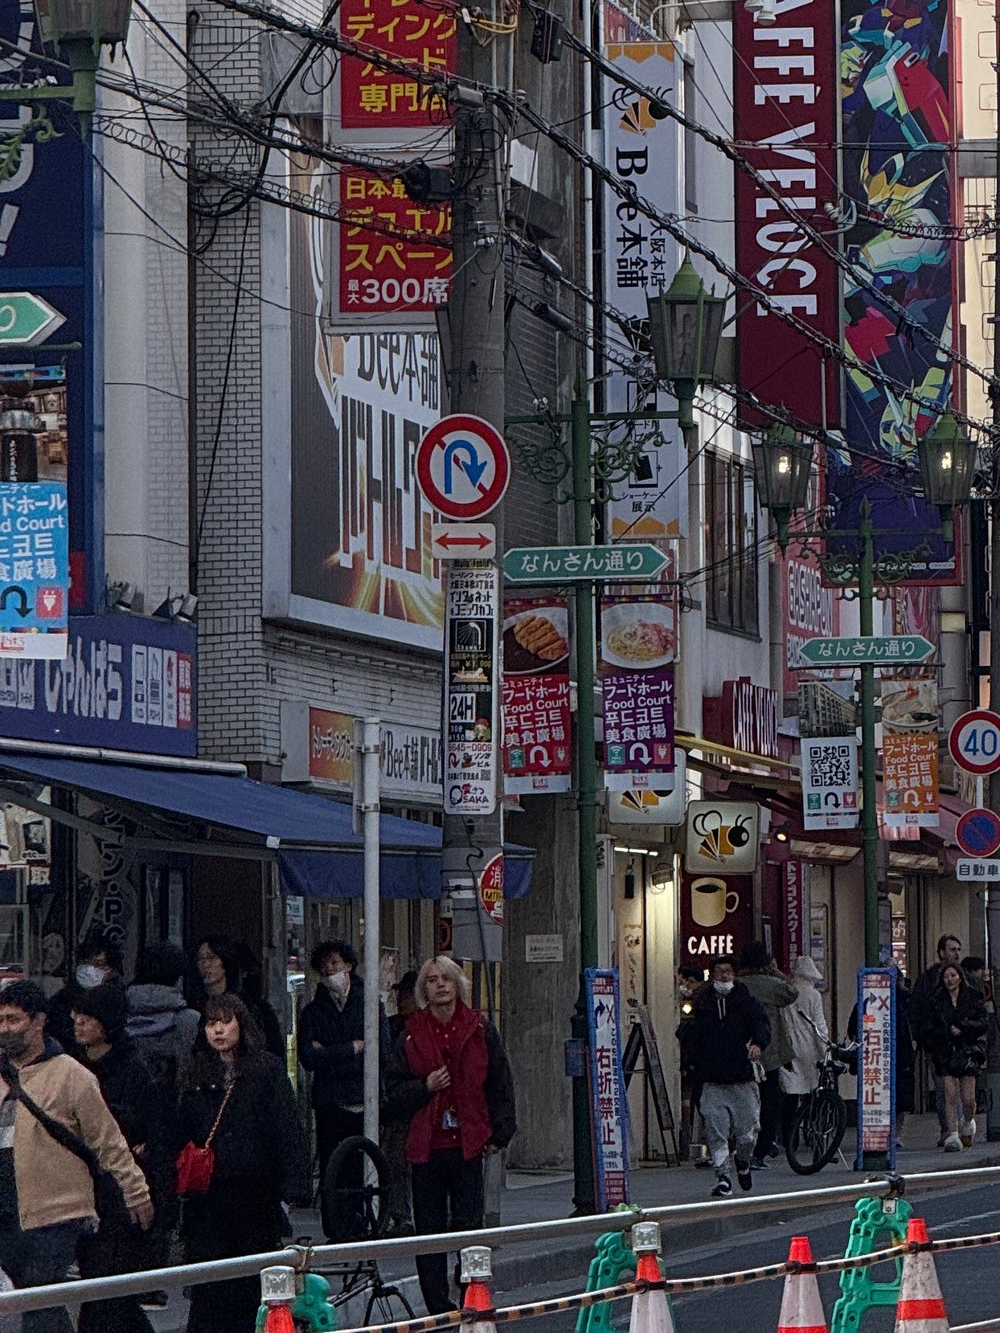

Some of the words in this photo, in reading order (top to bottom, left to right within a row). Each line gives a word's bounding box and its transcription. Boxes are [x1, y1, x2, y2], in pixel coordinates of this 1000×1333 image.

[346, 13, 457, 43] ディング
[754, 122, 817, 317] VELOCE
[361, 277, 450, 305] 300席
[16, 514, 65, 531] Court
[521, 550, 643, 572] なんさん通り
[818, 639, 915, 656] なんさん通り
[604, 674, 655, 685] コミュニティー
[604, 680, 673, 699] フードホール
[502, 681, 570, 704] フードホール
[450, 695, 475, 721] 24H
[504, 700, 534, 714] Food
[535, 696, 569, 710] Court
[604, 699, 635, 711] Food
[637, 695, 672, 707] Court
[504, 709, 562, 729] 푸드코트
[604, 706, 664, 727] 푸드코트
[504, 726, 565, 747] 美食廣場
[604, 724, 667, 744] 美食廣場
[964, 728, 998, 756] 40
[885, 742, 938, 755] フードホール
[885, 755, 909, 764] Food
[910, 752, 936, 762] Court
[885, 762, 931, 776] 푸드코트
[885, 774, 933, 790] 美食廣場
[958, 862, 999, 876] 自動車
[687, 933, 734, 955] CAFFÈ
[863, 1028, 882, 1106] 右折禁止
[596, 1046, 616, 1146] 右折禁止
